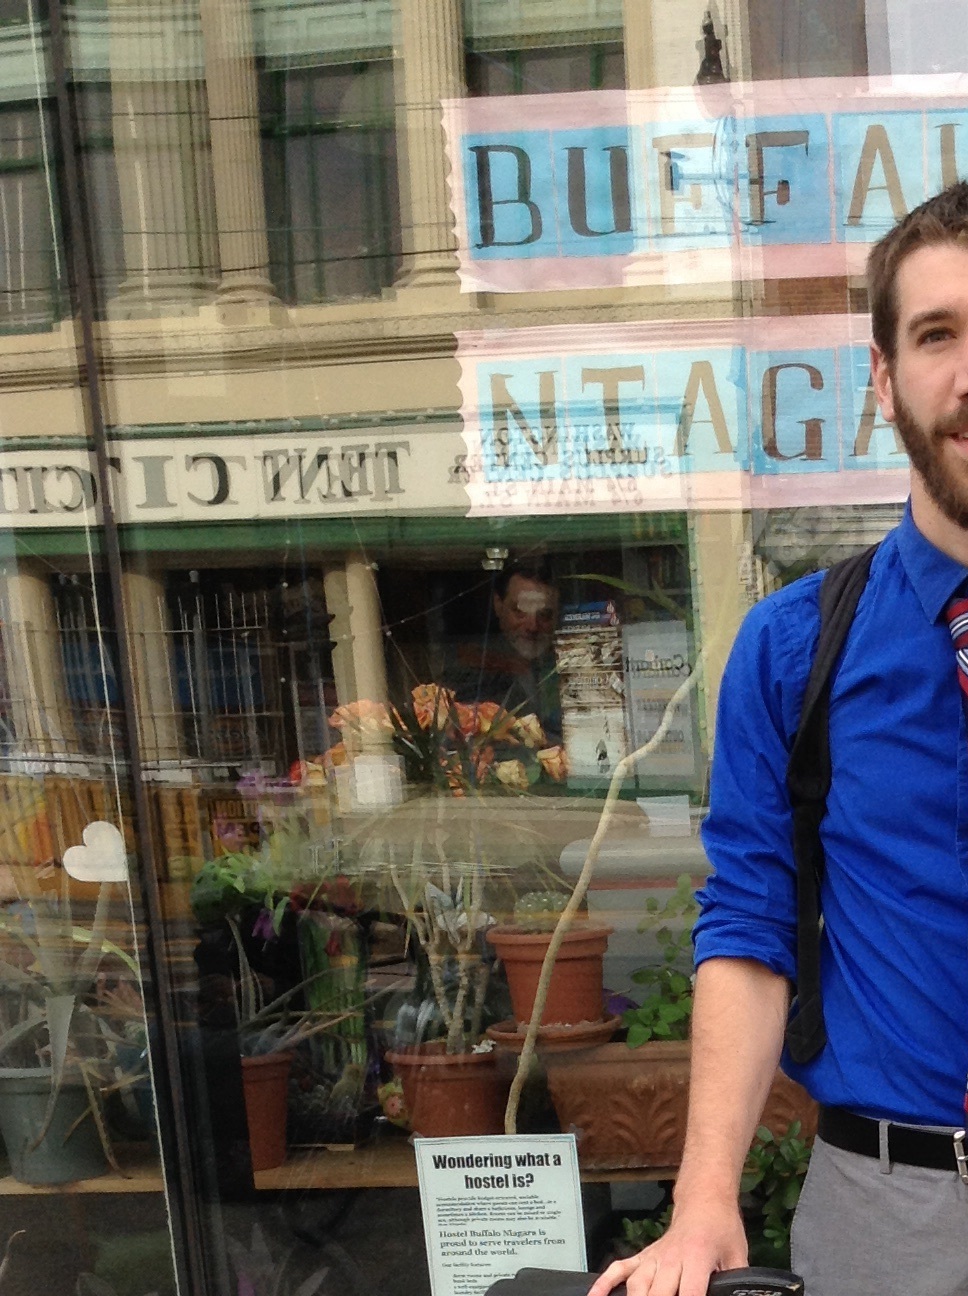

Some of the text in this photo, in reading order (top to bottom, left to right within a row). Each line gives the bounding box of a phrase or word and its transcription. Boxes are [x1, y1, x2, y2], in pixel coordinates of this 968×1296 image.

[432, 1152, 561, 1169] Wondering what a
[464, 1173, 534, 1189] hostel is?
